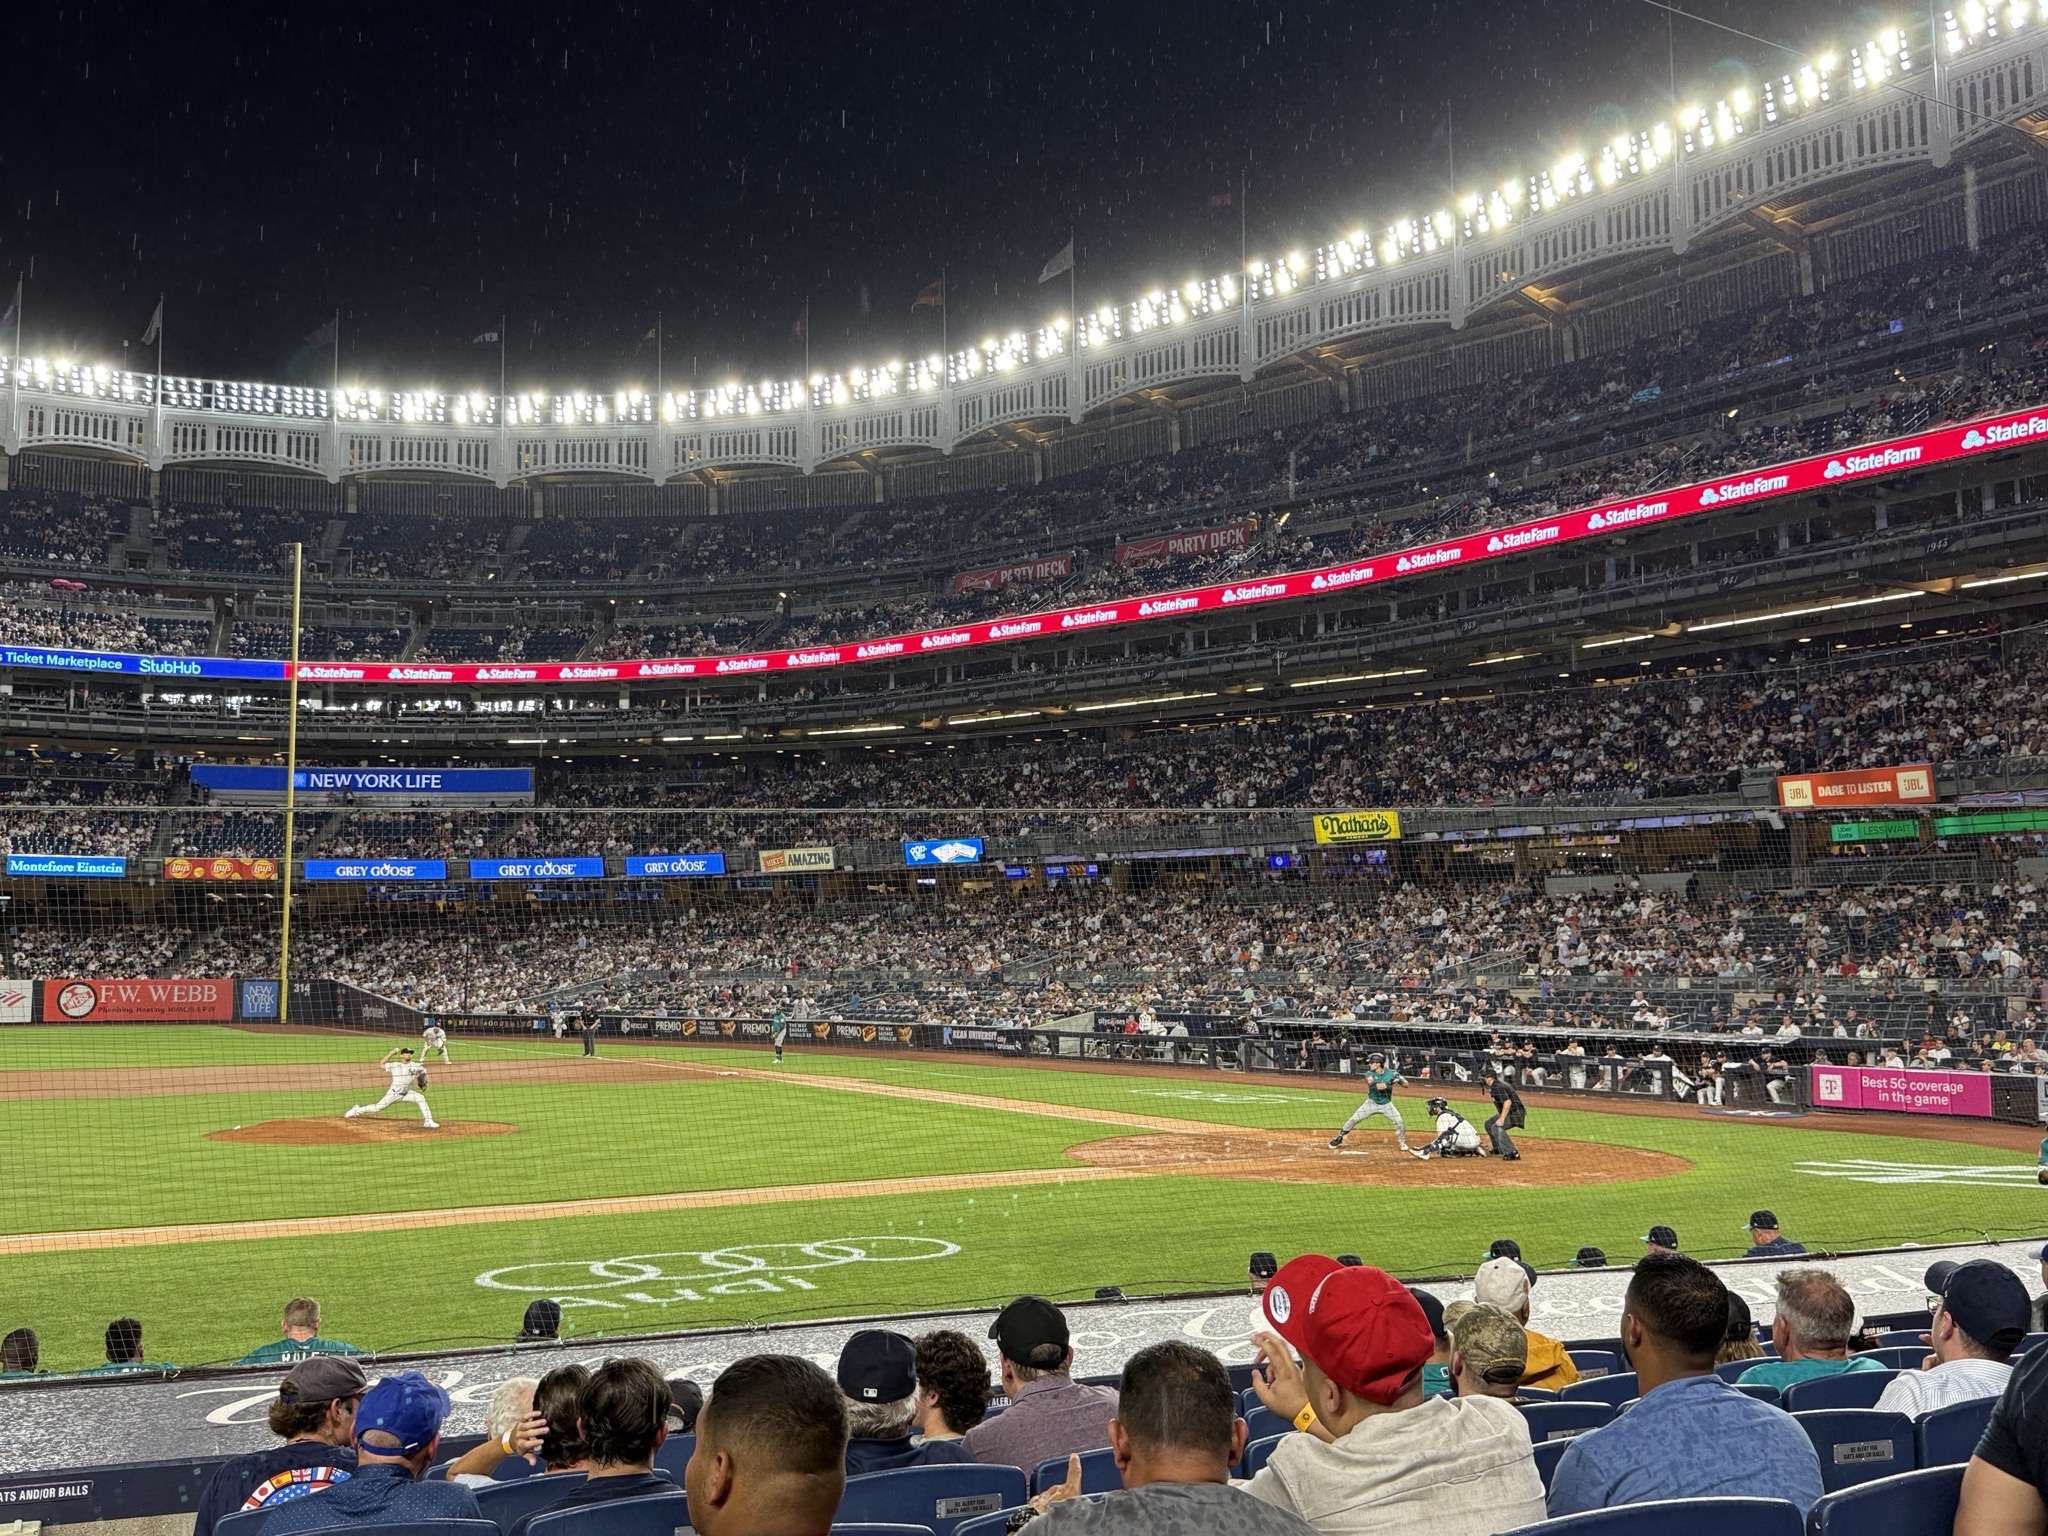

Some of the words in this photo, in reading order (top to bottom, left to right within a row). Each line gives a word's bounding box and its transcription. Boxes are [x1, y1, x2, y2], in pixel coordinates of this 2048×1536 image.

[1986, 417, 2048, 443] StateFa
[1169, 534, 1207, 554] PARTY
[1211, 527, 1244, 549] DECK
[1000, 565, 1034, 583] PARTY
[1037, 559, 1066, 578] DECK
[6, 652, 43, 664] Ticket
[47, 655, 122, 669] Marketplace
[139, 659, 201, 674] StubHub
[310, 773, 351, 788] NEW
[353, 774, 402, 788] YORK
[406, 774, 441, 788] LIFE
[1904, 778, 1923, 791] JBL
[1790, 788, 1807, 800] JBL
[1818, 785, 1844, 797] DARE
[1846, 784, 1856, 795] TO
[1858, 781, 1891, 794] LISTEN
[1321, 814, 1389, 835] Nathan's
[1863, 826, 1884, 835] LESS
[1886, 824, 1911, 833] WAIT
[644, 862, 668, 873] GREY
[671, 858, 706, 872] GOOSE
[788, 853, 831, 866] AMAZING
[10, 860, 75, 873] Montefiore
[77, 862, 123, 874] Einstein
[336, 866, 368, 877] GREY
[371, 863, 414, 877] GOOSE
[499, 865, 530, 876] GREY
[532, 861, 575, 875] GOOSE
[100, 984, 141, 1003] F.W.
[149, 984, 217, 1003] WEBB
[249, 985, 272, 995] NEW
[294, 983, 310, 993] 314
[245, 994, 275, 1004] YORK
[249, 1002, 271, 1012] LIFE
[655, 1020, 681, 1031] PREMIO
[742, 1023, 770, 1034] PREMIO
[836, 1025, 861, 1037] PREMIO
[952, 1029, 967, 1039] KEAN
[968, 1030, 997, 1040] UNIVERSITY
[1862, 1076, 1888, 1089] Best
[1890, 1078, 1907, 1090] 5G
[1910, 1081, 1964, 1095] coverage
[1879, 1090, 1889, 1101] in
[1891, 1091, 1910, 1104] the
[1915, 1094, 1949, 1108] game
[0, 1490, 17, 1502] ATS
[19, 1487, 56, 1501] AND/OR
[58, 1484, 89, 1497] BALLS
